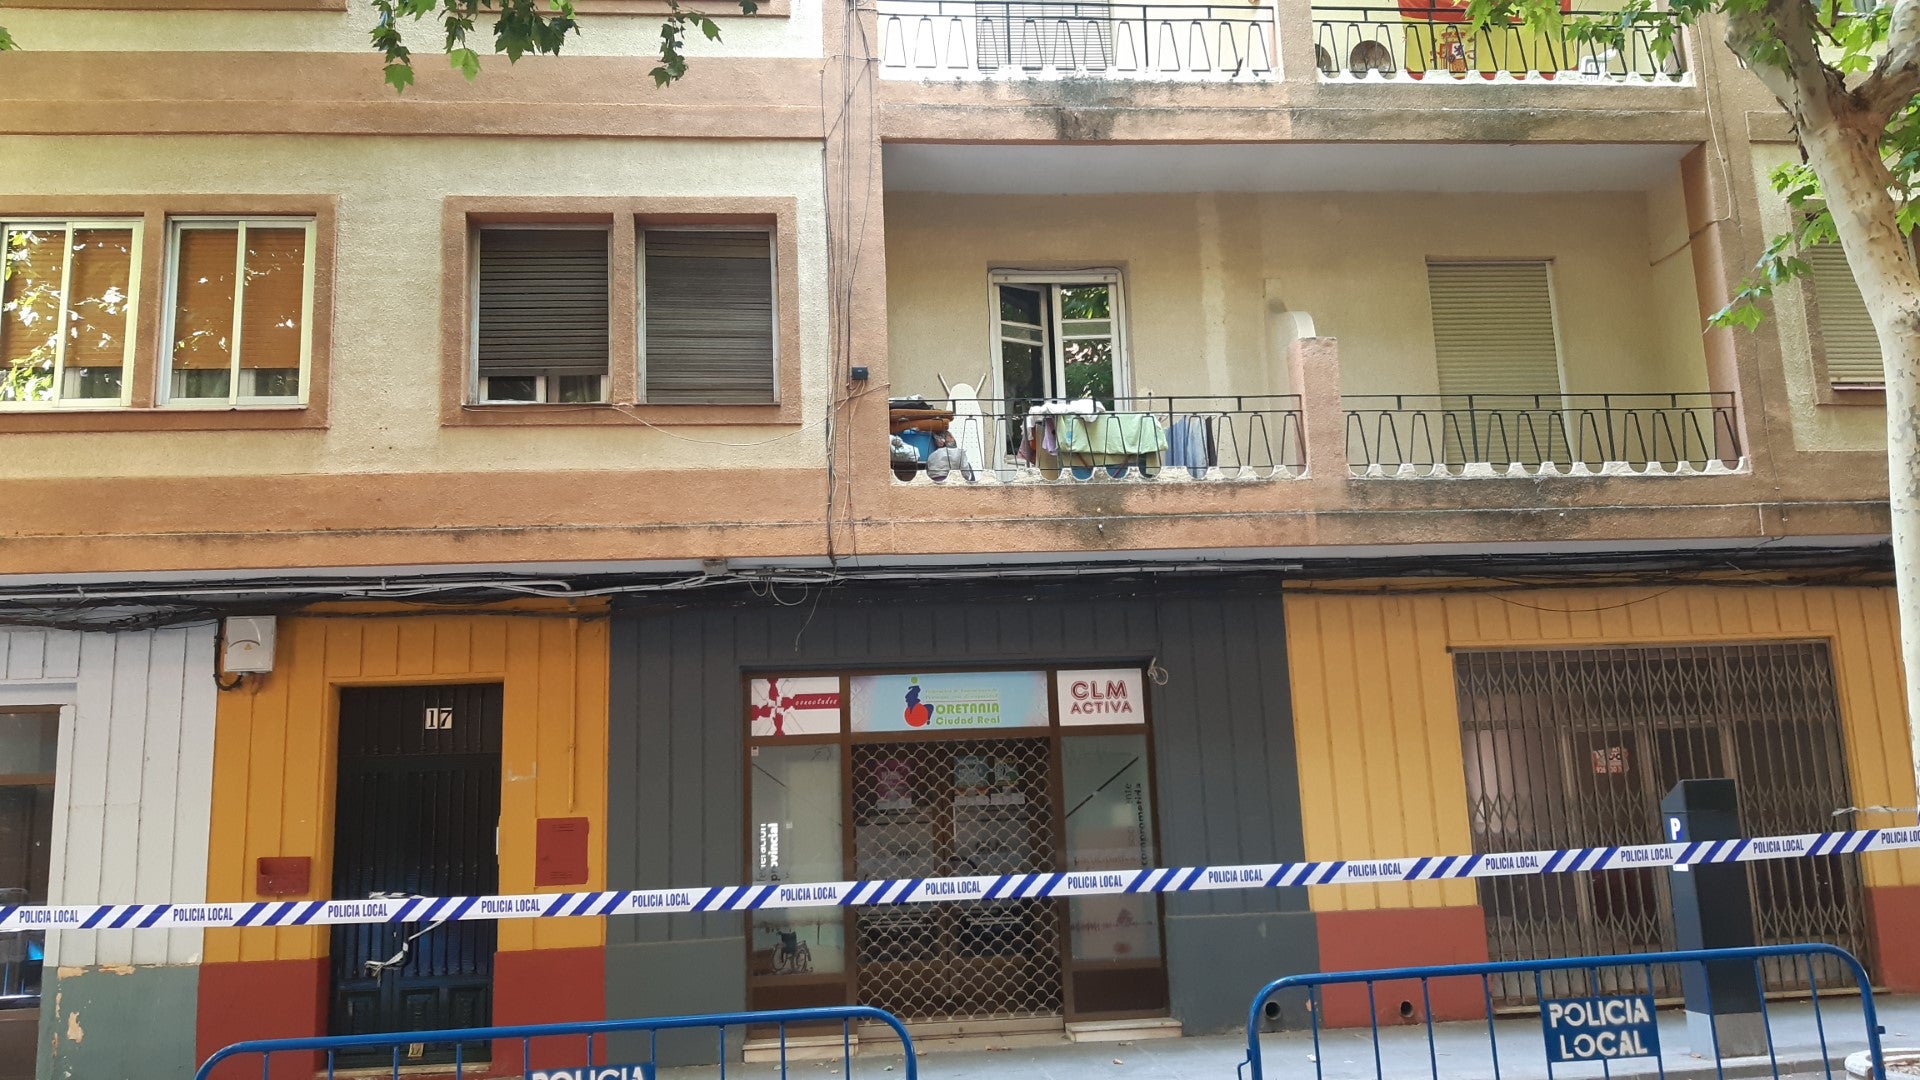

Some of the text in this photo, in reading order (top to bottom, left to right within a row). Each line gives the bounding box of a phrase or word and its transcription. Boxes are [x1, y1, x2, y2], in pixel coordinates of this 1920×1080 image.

[1071, 680, 1127, 701] CLM
[935, 703, 1000, 715] ORETANIA
[1070, 700, 1133, 715] ACTIVA
[428, 709, 453, 728] 17
[935, 715, 1001, 726] Ciudad Real
[1670, 817, 1681, 841] P
[1881, 830, 1920, 844] POLICIA LOC
[1753, 839, 1804, 854] POLICIA LOCAL
[1485, 855, 1539, 870] POLICIA LOCAL
[1620, 848, 1674, 862] POLICIA LOCAL
[1208, 868, 1263, 883] POLICIA LOCAL
[1348, 862, 1402, 877] POLICIA LOCAL
[925, 880, 981, 896] POLICIA LOCAL
[1067, 874, 1123, 889] POLICIA LOCAL
[632, 892, 690, 908] POLICIA LOCAL
[780, 886, 837, 902] POLICIA LOCAL
[328, 903, 388, 918] POLICIA LOCAL
[481, 898, 540, 913] POLICIA LOCAL
[19, 909, 79, 923] POLICIA LOCAL
[173, 907, 233, 922] POLICIA LOCAL
[1548, 999, 1650, 1028] POLICIA
[1560, 1030, 1648, 1059] LOCAL
